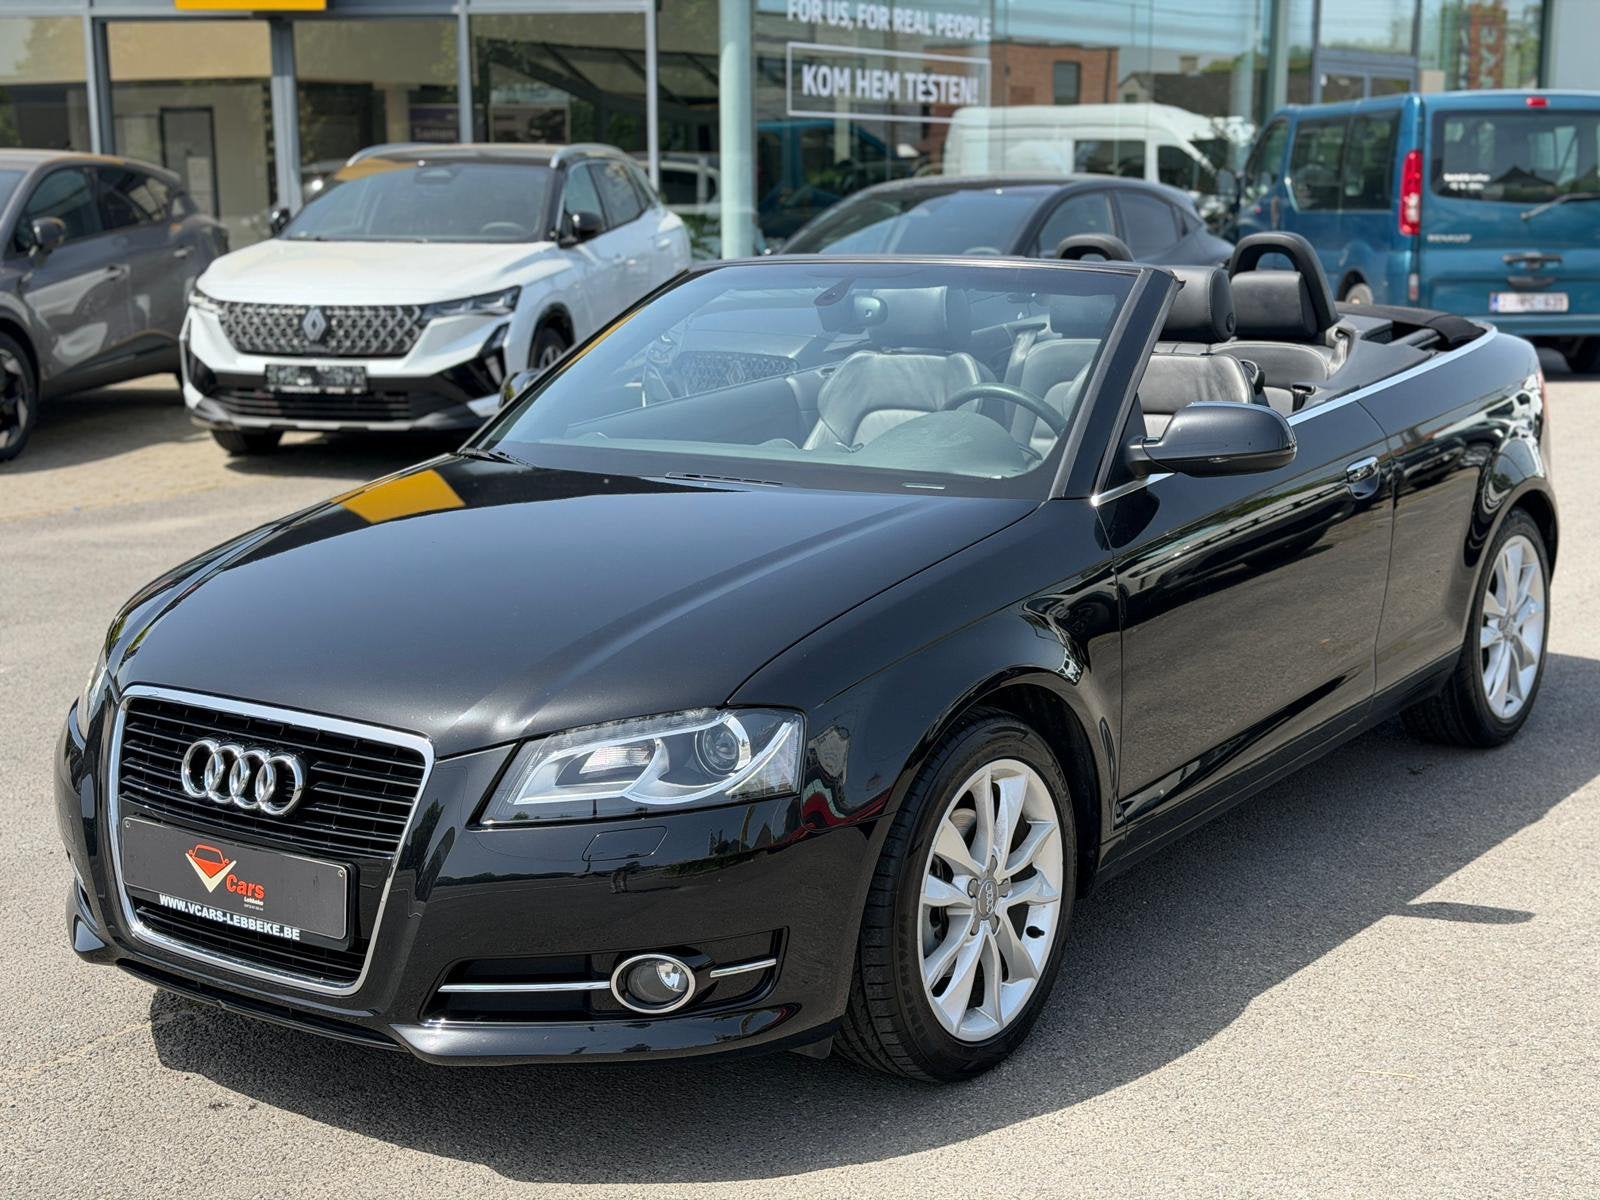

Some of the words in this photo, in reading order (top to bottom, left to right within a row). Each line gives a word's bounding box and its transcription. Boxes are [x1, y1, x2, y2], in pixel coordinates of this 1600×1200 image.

[786, 0, 822, 23] FOR
[826, 1, 854, 31] US,
[856, 4, 890, 31] FOR
[892, 8, 933, 36] REAL
[936, 13, 991, 41] PEOPLE
[802, 64, 851, 97] KOM
[855, 67, 901, 101] HEM
[903, 72, 979, 105] TESTEN!
[226, 874, 265, 898] Cars
[159, 893, 301, 941] WWW.VCARS-LEBBEKE.BE
